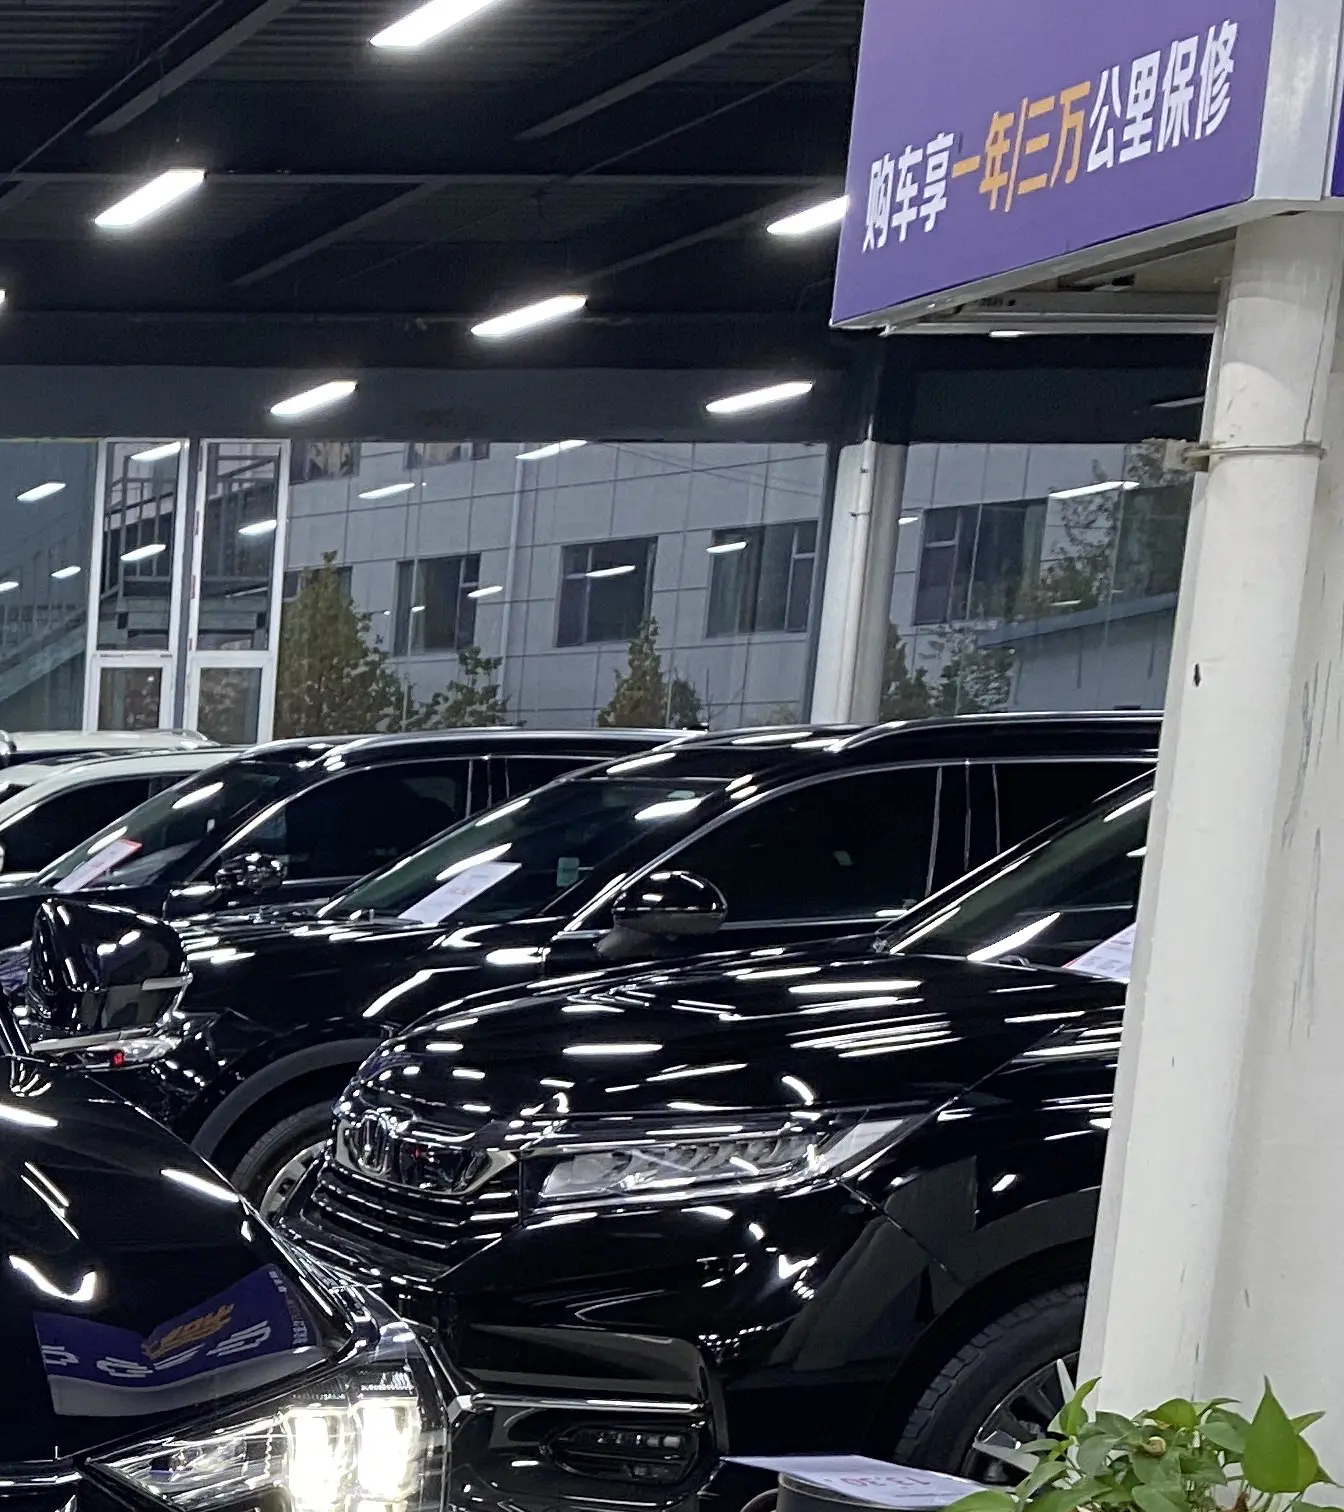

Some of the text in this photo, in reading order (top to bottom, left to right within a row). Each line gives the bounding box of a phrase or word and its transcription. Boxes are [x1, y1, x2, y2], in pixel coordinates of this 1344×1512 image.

[861, 20, 1239, 252] 购车享一年/三万公里保修
